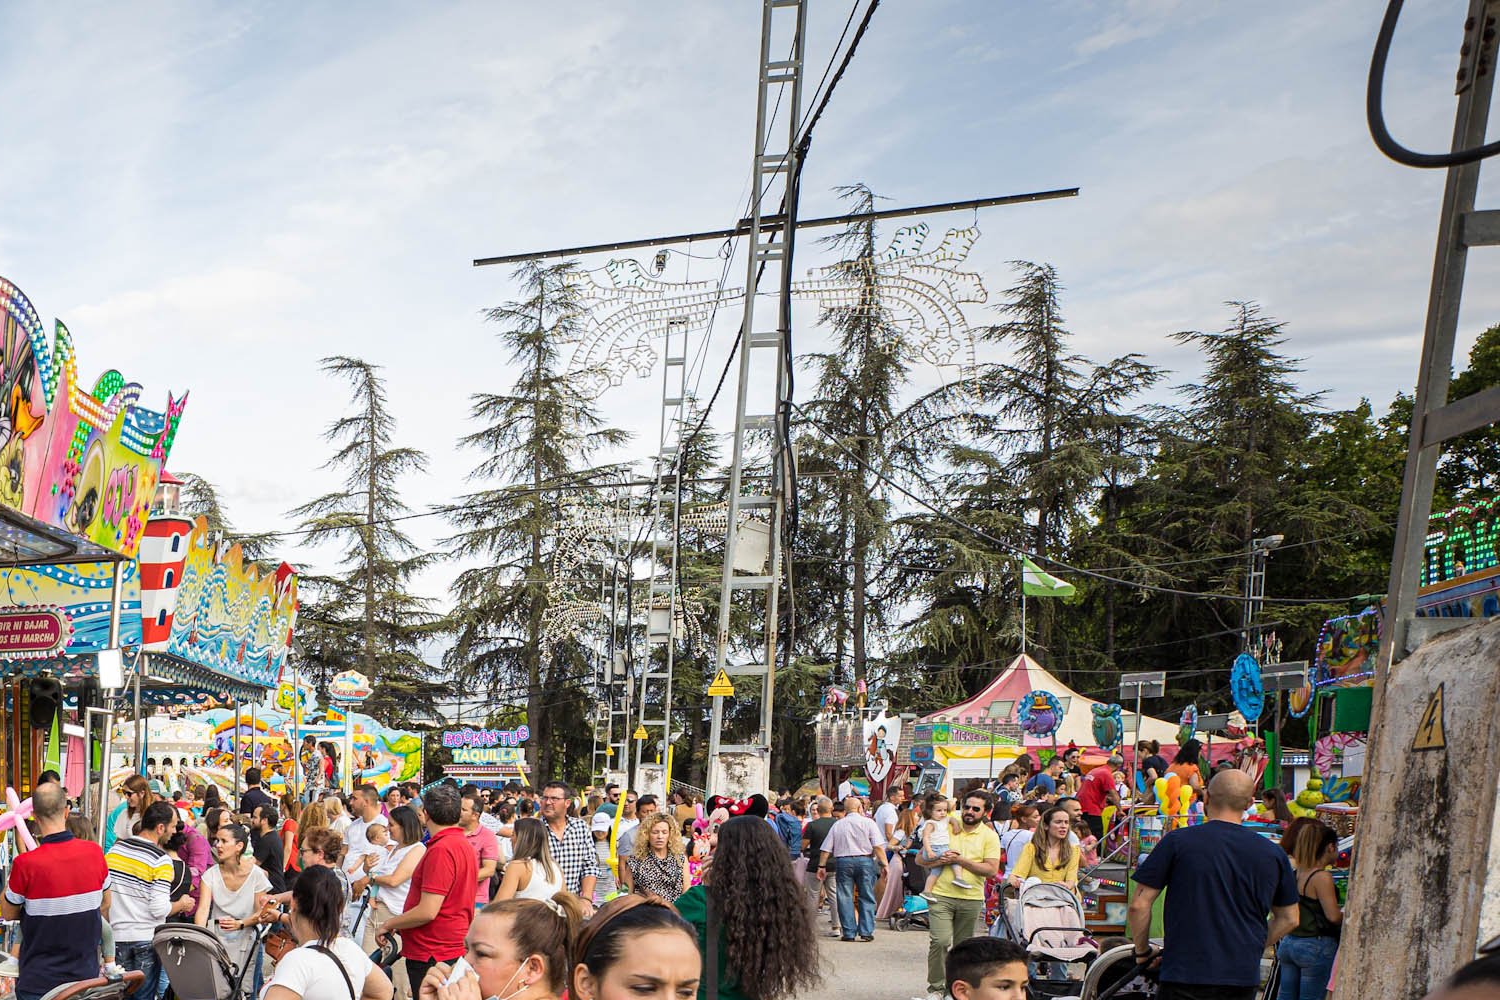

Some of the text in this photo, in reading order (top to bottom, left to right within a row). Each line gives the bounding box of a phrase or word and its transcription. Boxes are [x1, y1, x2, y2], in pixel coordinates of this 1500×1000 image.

[13, 620, 22, 631] NI
[24, 619, 49, 630] BAJAR
[10, 634, 20, 643] EN
[22, 632, 55, 643] MARCHA
[500, 726, 529, 746] TUG
[452, 748, 519, 762] TAQUILLA
